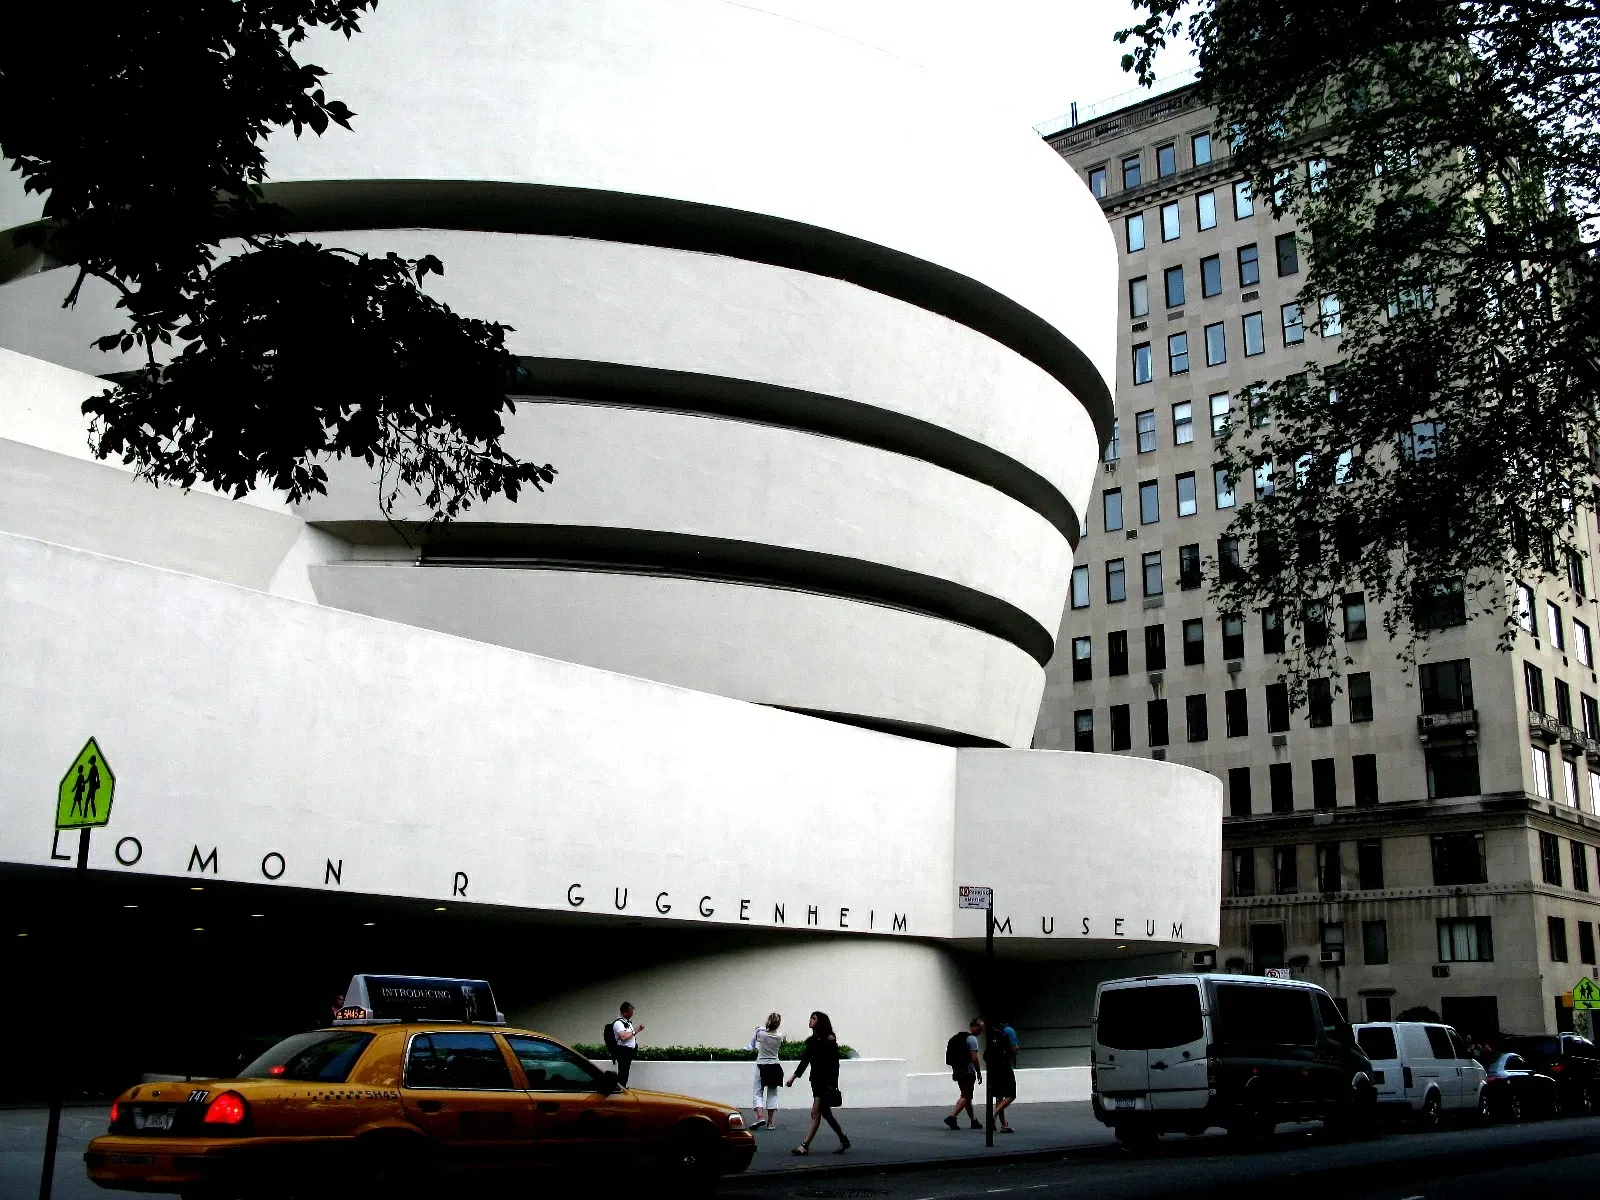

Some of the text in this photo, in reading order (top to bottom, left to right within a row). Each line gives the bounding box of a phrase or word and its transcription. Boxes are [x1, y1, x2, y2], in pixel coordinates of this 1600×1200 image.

[51, 829, 1183, 939] LOMON R GUGGENHEIM MUSEUM
[380, 987, 452, 999] INTRODUCING
[188, 1090, 209, 1103] 747
